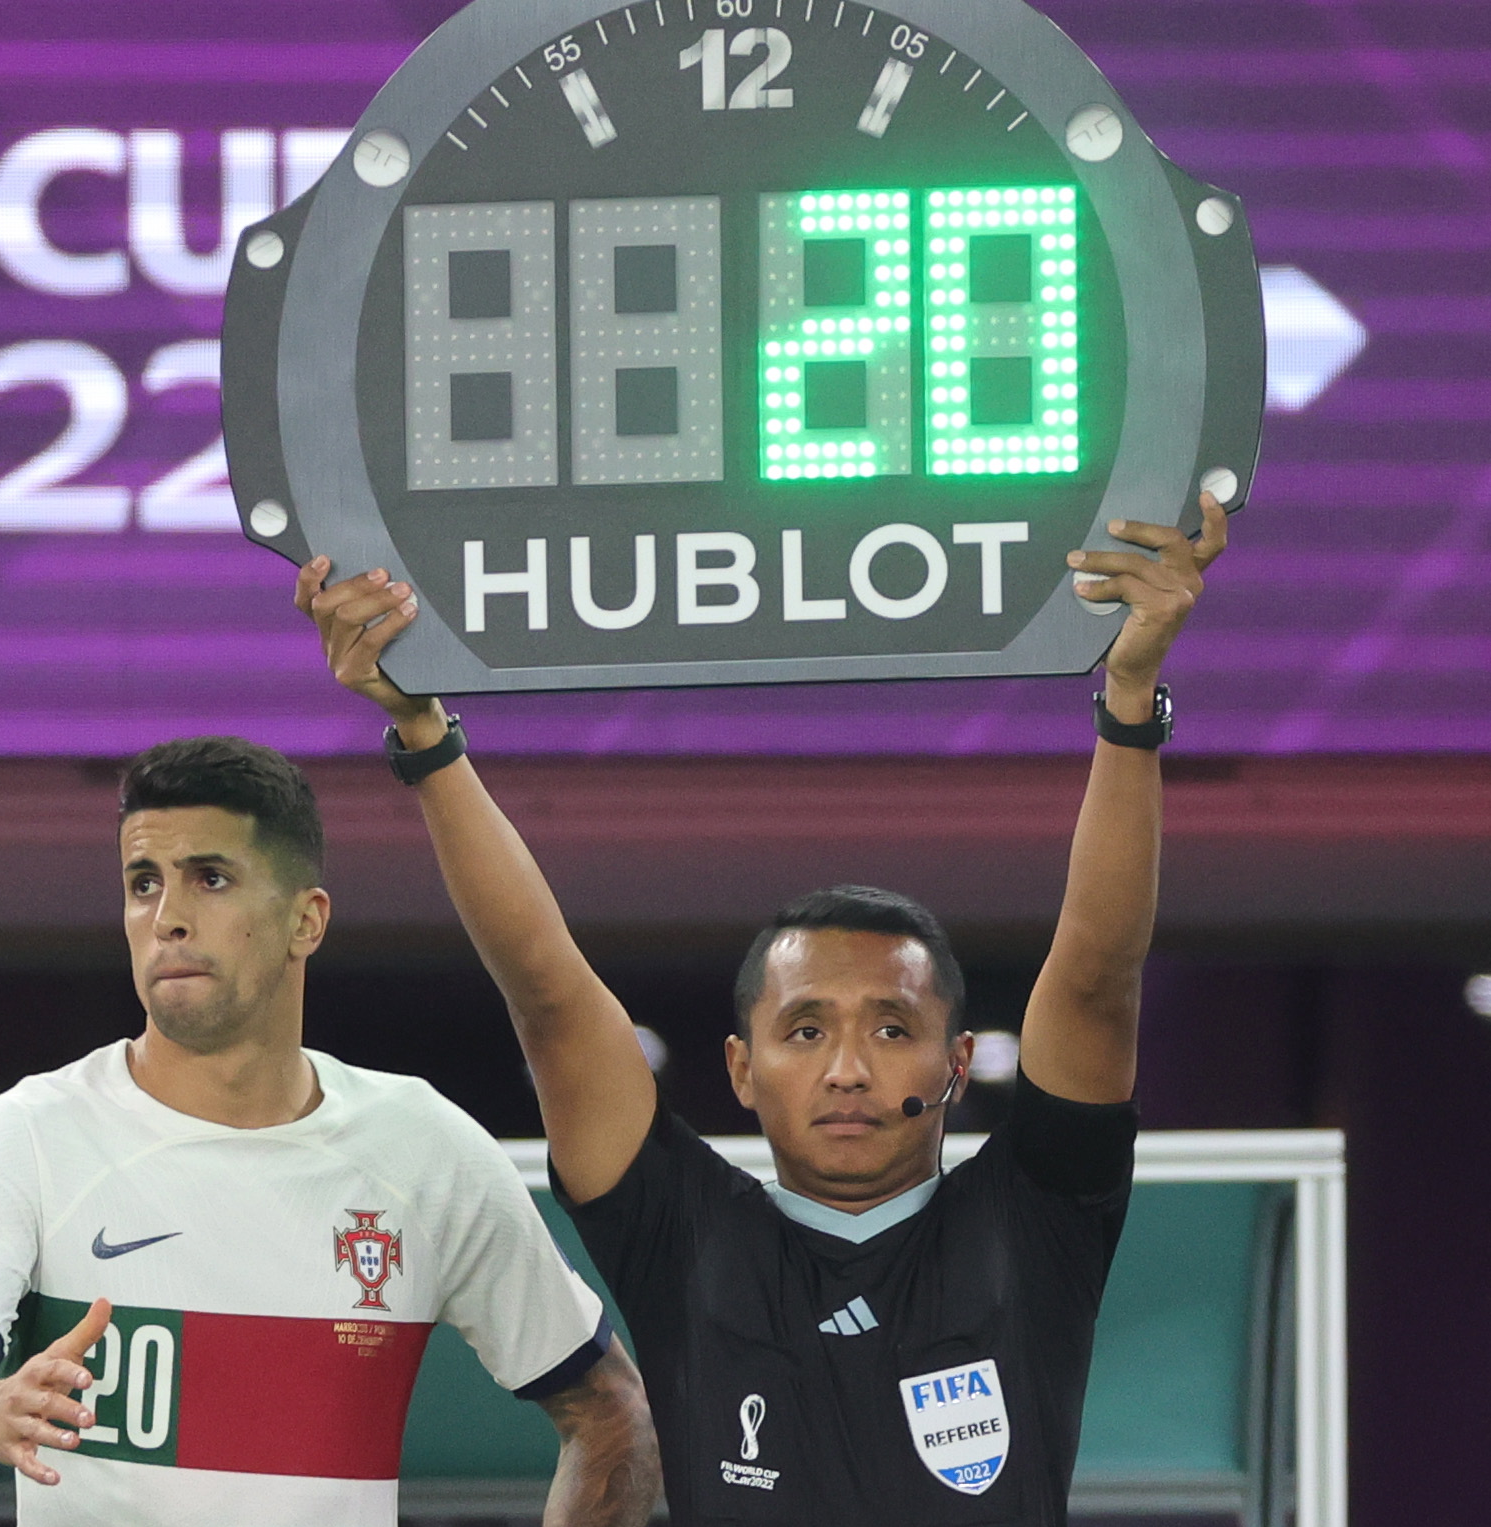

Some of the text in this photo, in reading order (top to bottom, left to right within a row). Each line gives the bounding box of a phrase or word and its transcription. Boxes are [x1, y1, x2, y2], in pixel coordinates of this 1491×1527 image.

[543, 35, 582, 72] 55
[889, 24, 929, 59] 05
[679, 27, 794, 111] 12
[759, 187, 1079, 480] 20
[463, 521, 1029, 632] HUBLOT
[79, 1322, 174, 1449] 20
[911, 1369, 993, 1413] FIFA
[923, 1418, 1002, 1450] REFEREE
[954, 1462, 992, 1484] 2022
